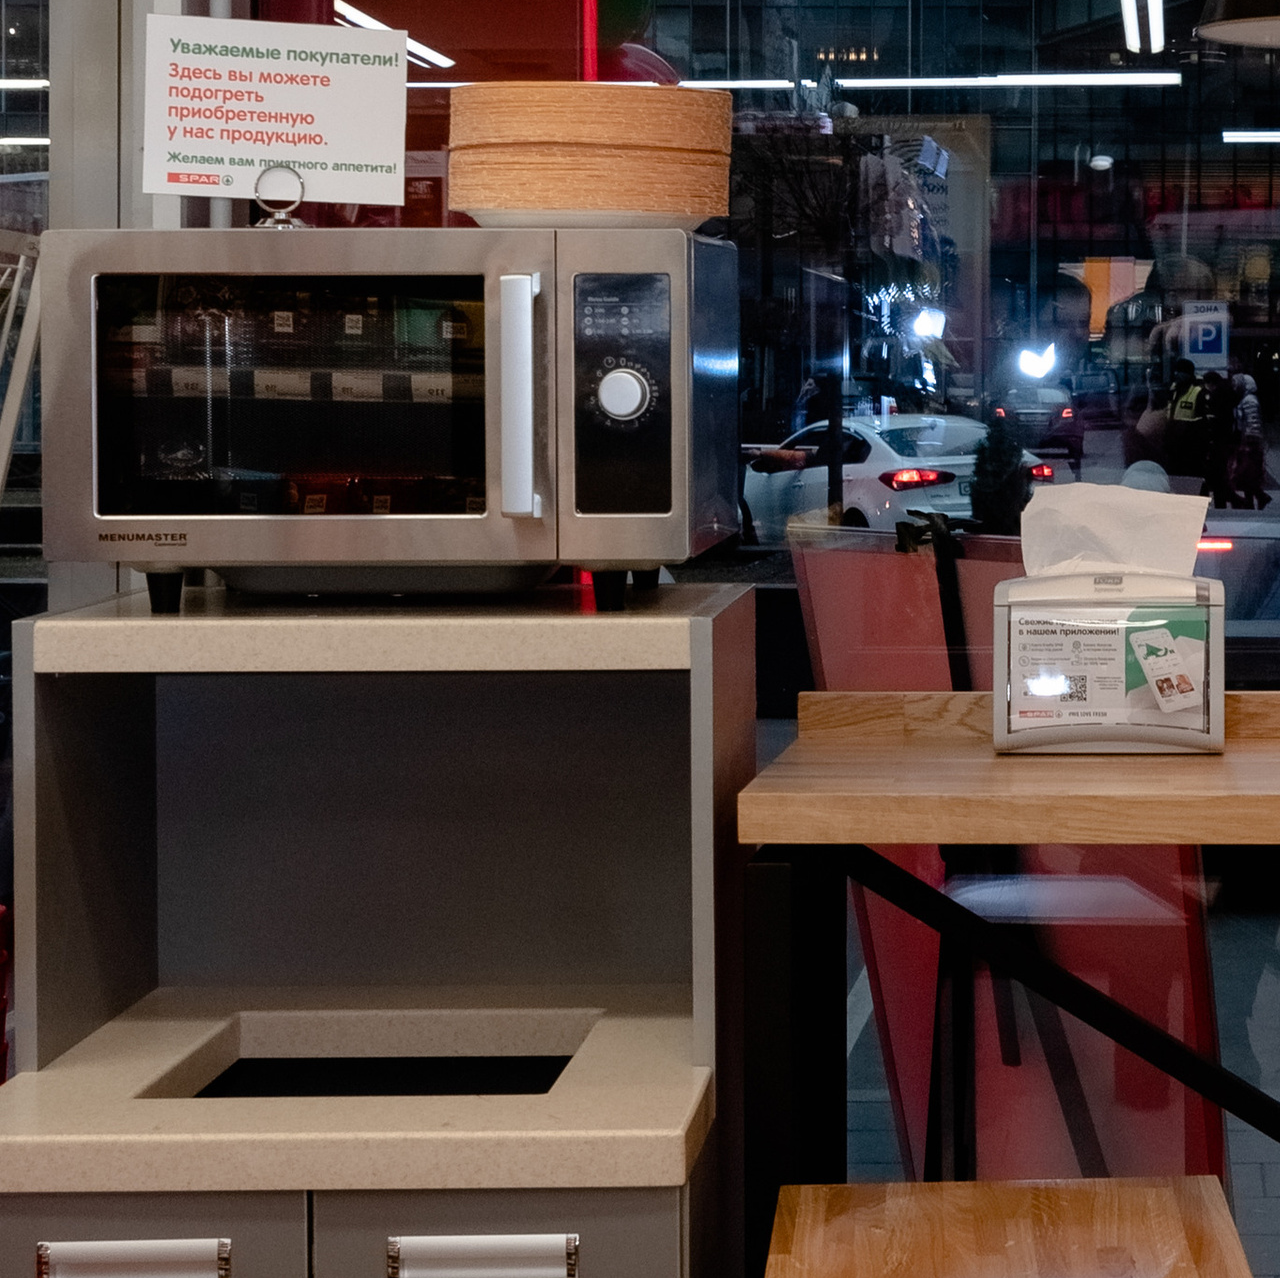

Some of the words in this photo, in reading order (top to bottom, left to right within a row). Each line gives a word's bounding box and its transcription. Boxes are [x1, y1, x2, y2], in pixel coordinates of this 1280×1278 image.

[170, 38, 281, 60] Уважаемые
[287, 50, 399, 68] покупатели!
[169, 63, 222, 82] Здесь
[228, 69, 254, 83] вы
[259, 72, 331, 88] можете
[168, 85, 265, 104] подогреть
[168, 105, 315, 128] приобретенную
[167, 125, 178, 141] у
[183, 126, 215, 139] нас
[220, 129, 328, 147] продукцию.
[167, 151, 225, 167] Желаем
[229, 158, 255, 168] вам
[259, 158, 328, 172] приятного
[332, 162, 397, 175] аппетита!
[178, 173, 220, 186] SPAR
[1194, 305, 1219, 313] ЗОНА
[1198, 324, 1217, 350] P
[98, 533, 187, 542] MENUMASTER
[1018, 628, 1025, 636] в
[1027, 628, 1058, 636] нашем
[1060, 628, 1120, 638] приложении!
